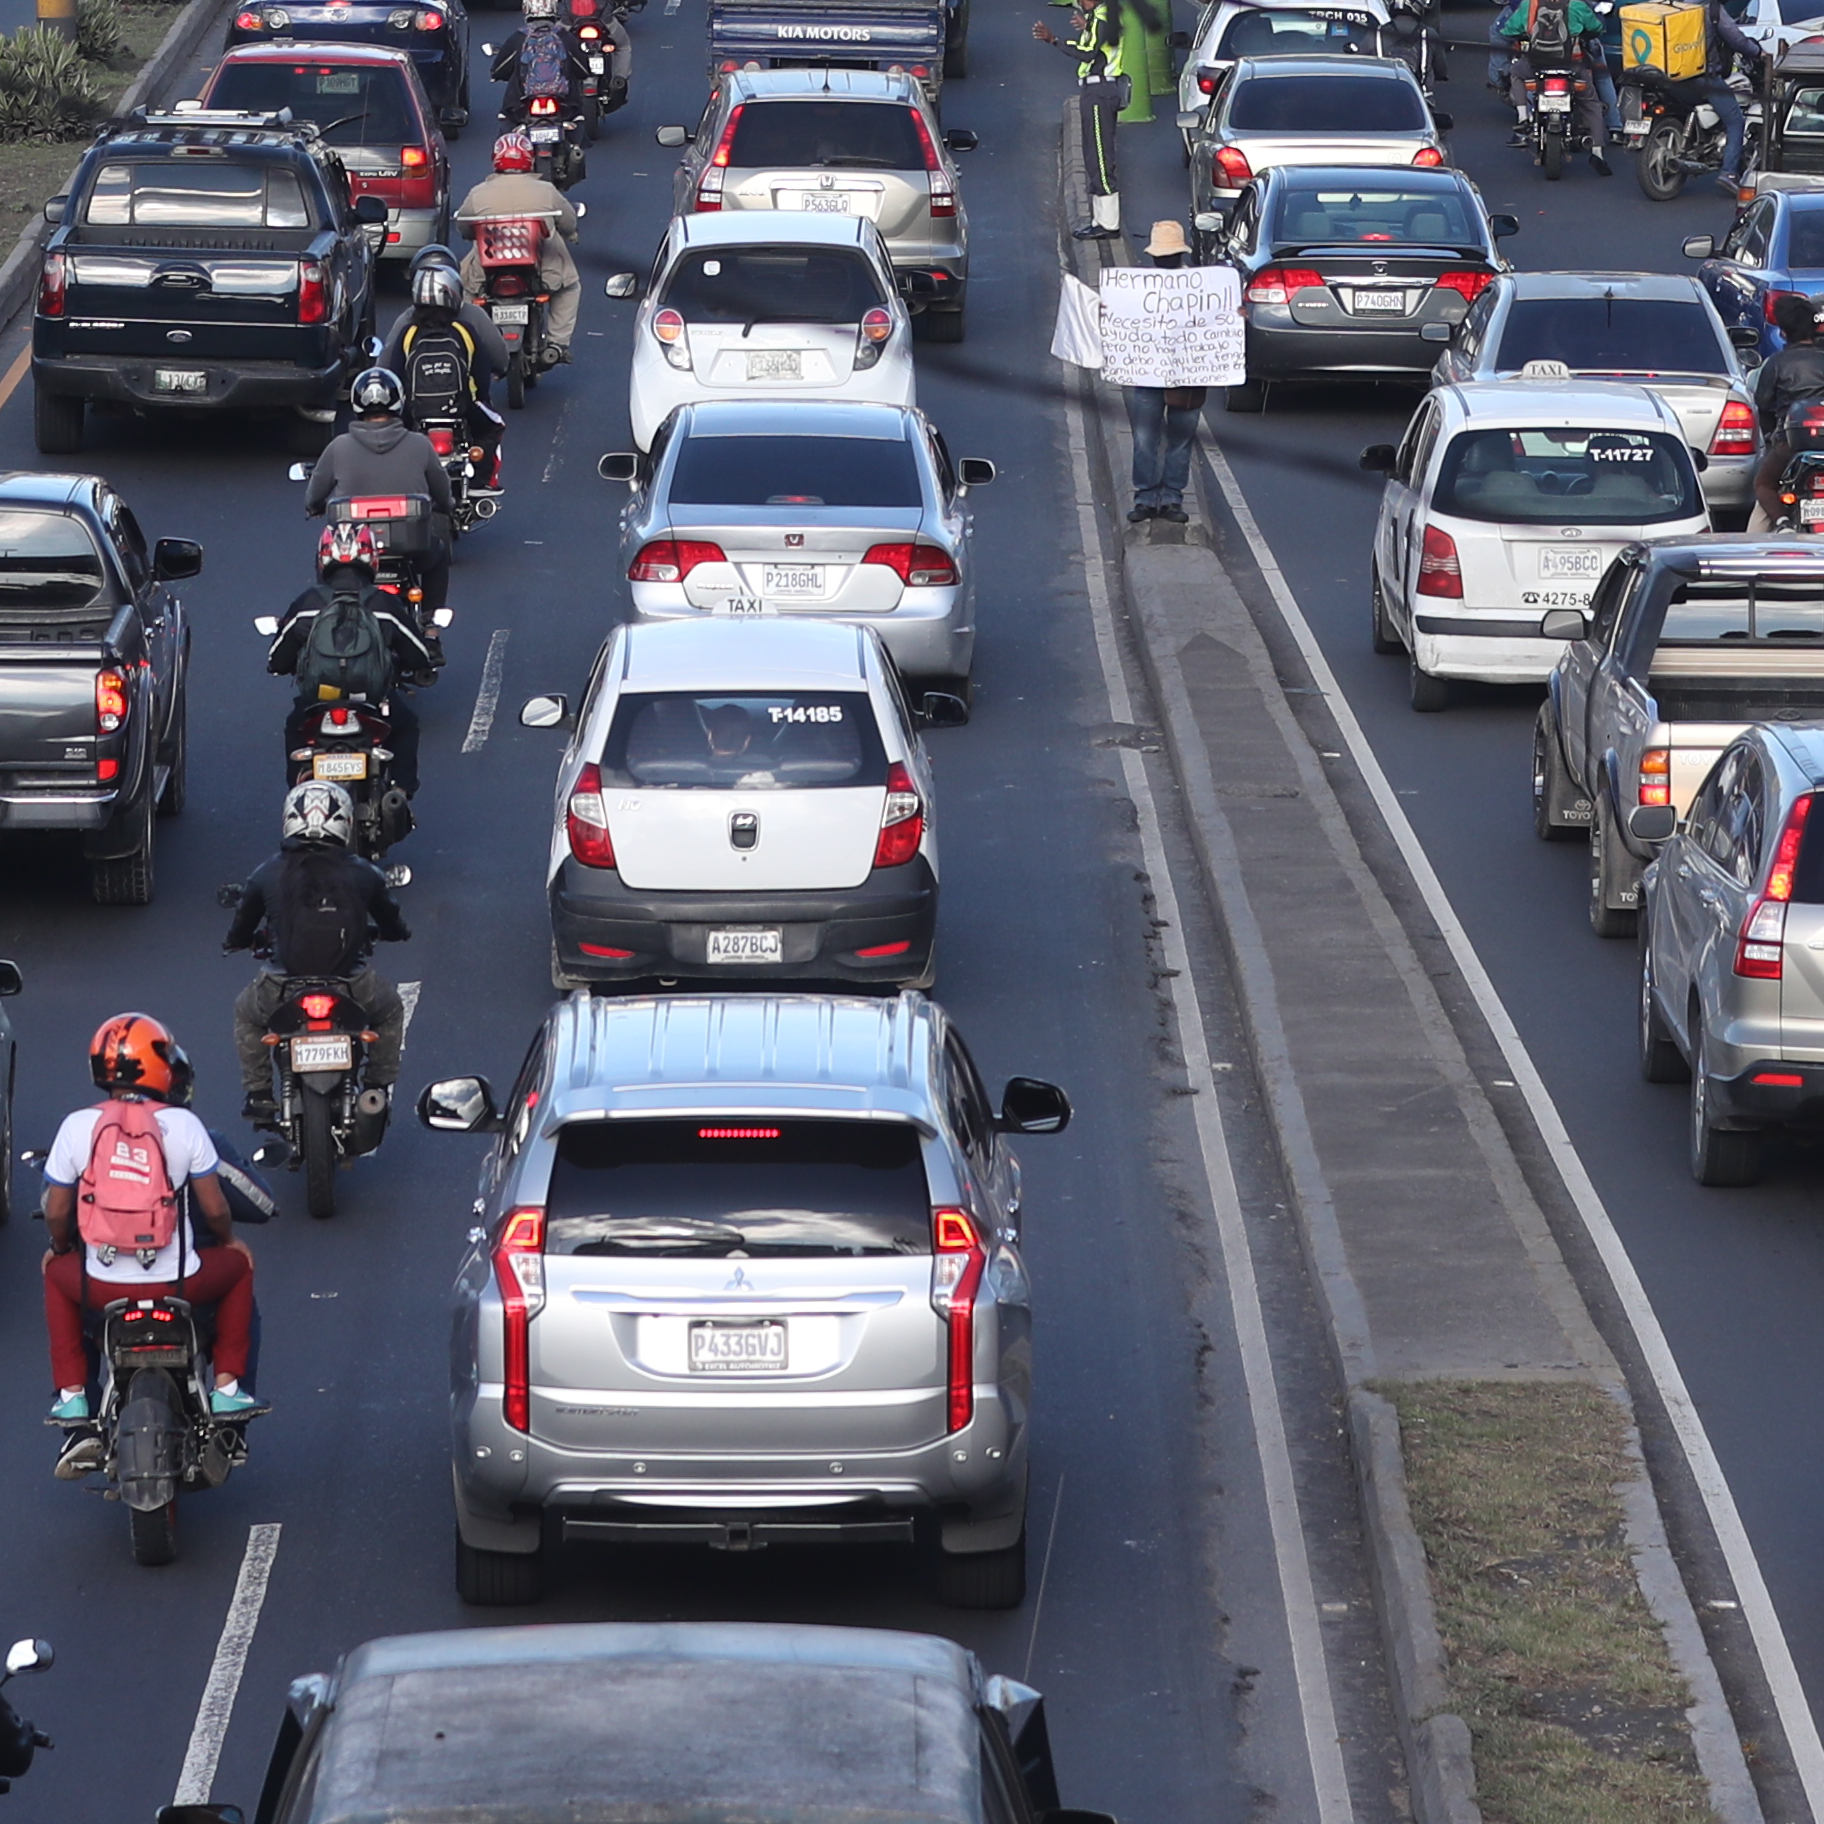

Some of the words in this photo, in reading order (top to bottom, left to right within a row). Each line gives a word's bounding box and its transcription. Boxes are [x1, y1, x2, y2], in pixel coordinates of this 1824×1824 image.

[777, 25, 803, 39] KIA
[806, 27, 870, 41] MOTORS
[1102, 311, 1178, 330] Necesito
[1185, 315, 1206, 328] de
[1162, 331, 1198, 346] todo
[1133, 342, 1150, 354] no
[1156, 344, 1176, 357] hay
[1182, 340, 1230, 354] trabajo
[1123, 353, 1155, 365] debo
[1181, 362, 1230, 376] hambre
[1529, 365, 1563, 376] TAXI
[1590, 448, 1653, 461] T-11727
[766, 572, 822, 588] P218GHL
[727, 598, 762, 613] TAXI
[768, 706, 843, 723] T-14185
[711, 935, 779, 954] A287BCJ
[694, 1333, 783, 1357] P433GVJ
